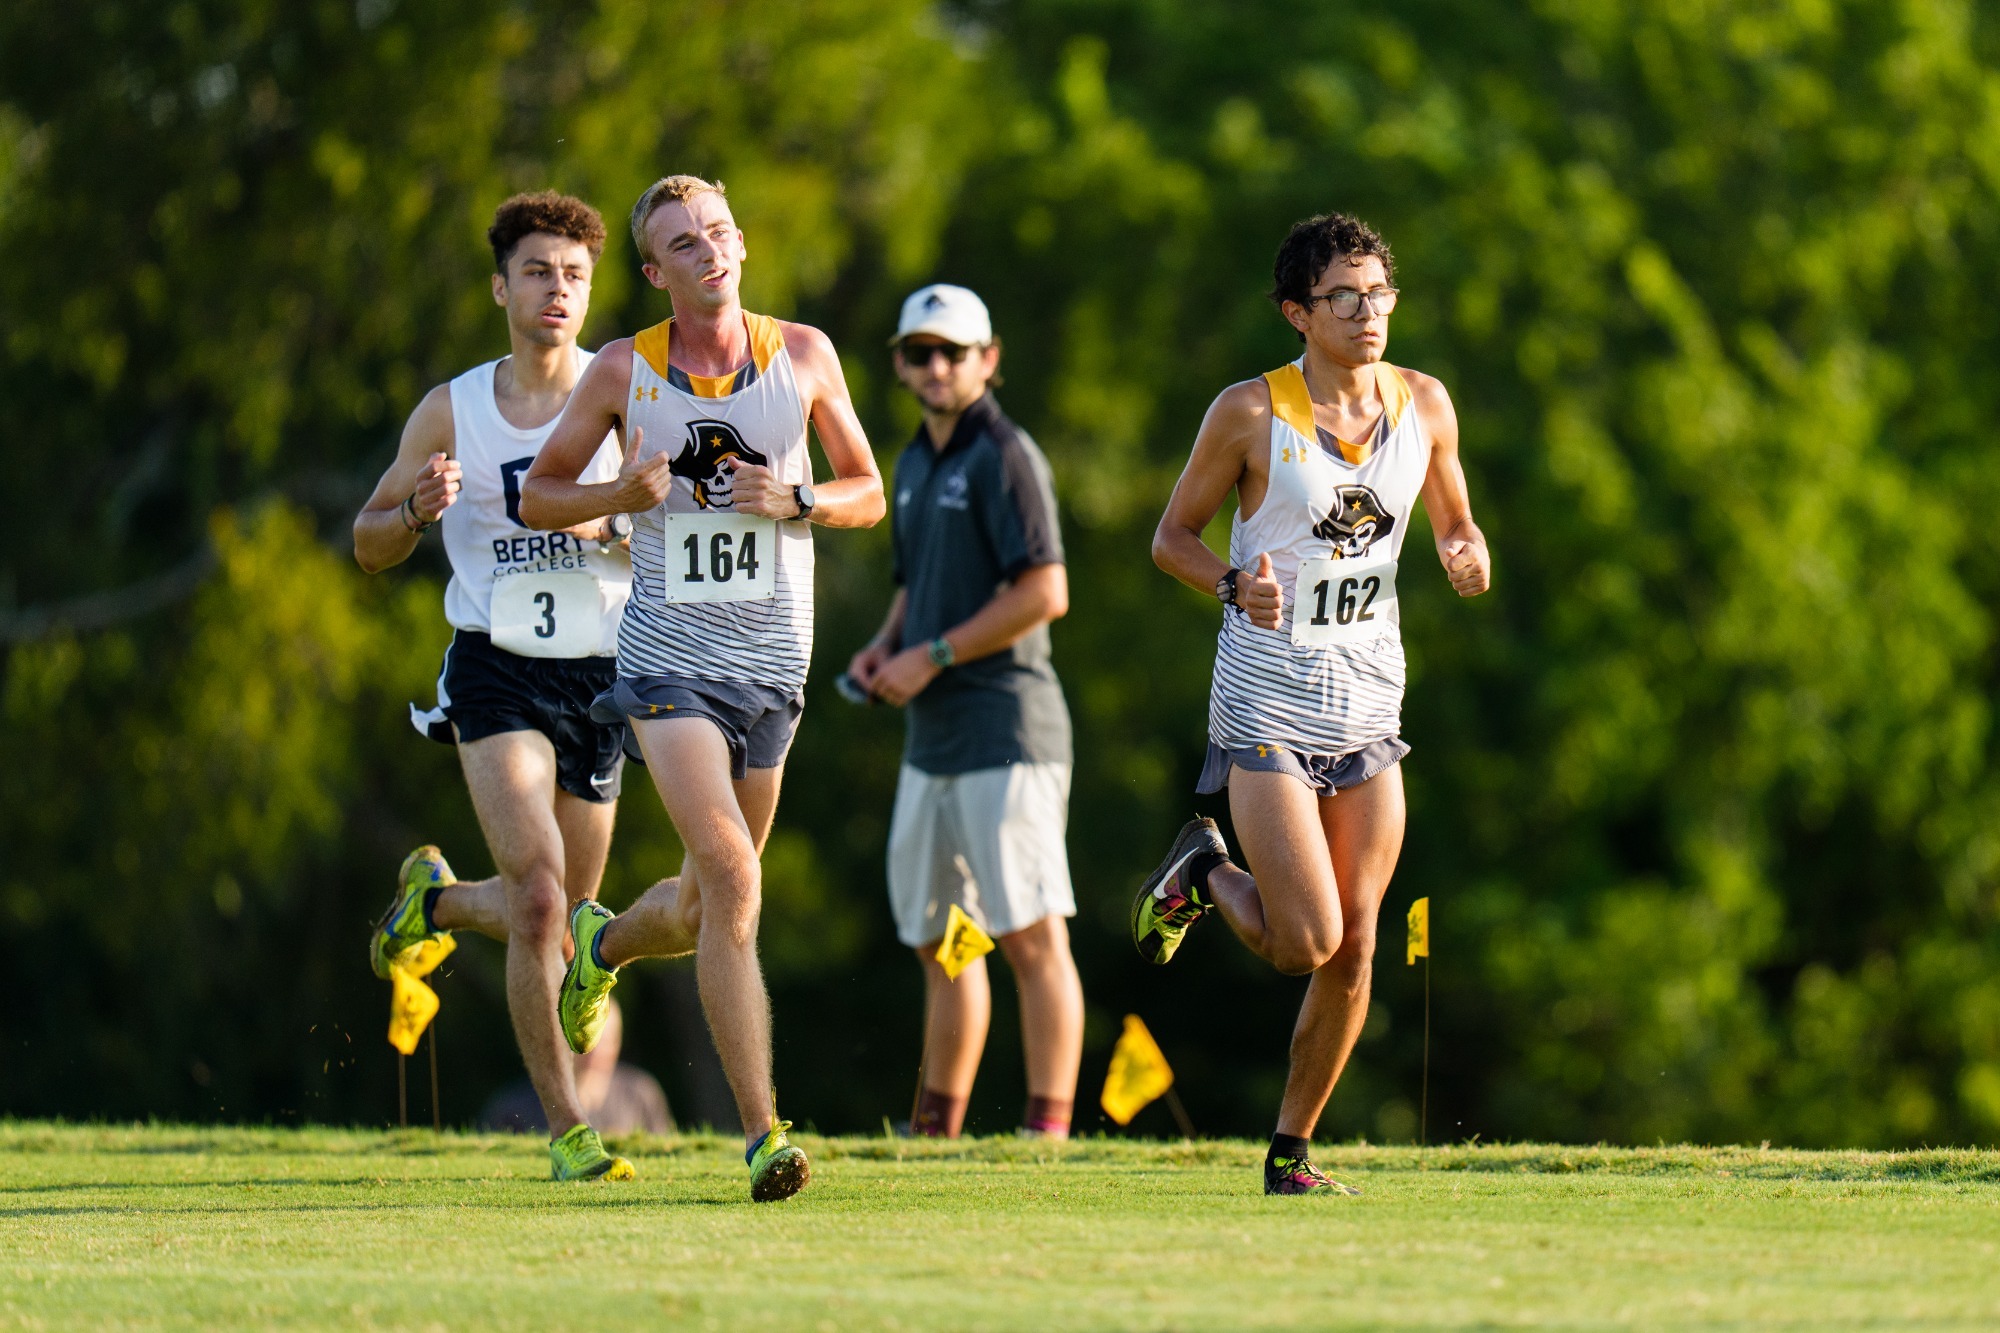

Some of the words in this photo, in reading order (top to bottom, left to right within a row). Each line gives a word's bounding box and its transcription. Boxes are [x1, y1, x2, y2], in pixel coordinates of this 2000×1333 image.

[493, 531, 583, 563] BERRY
[683, 531, 760, 583] 164
[533, 591, 556, 639] 3
[1310, 575, 1381, 626] 162
